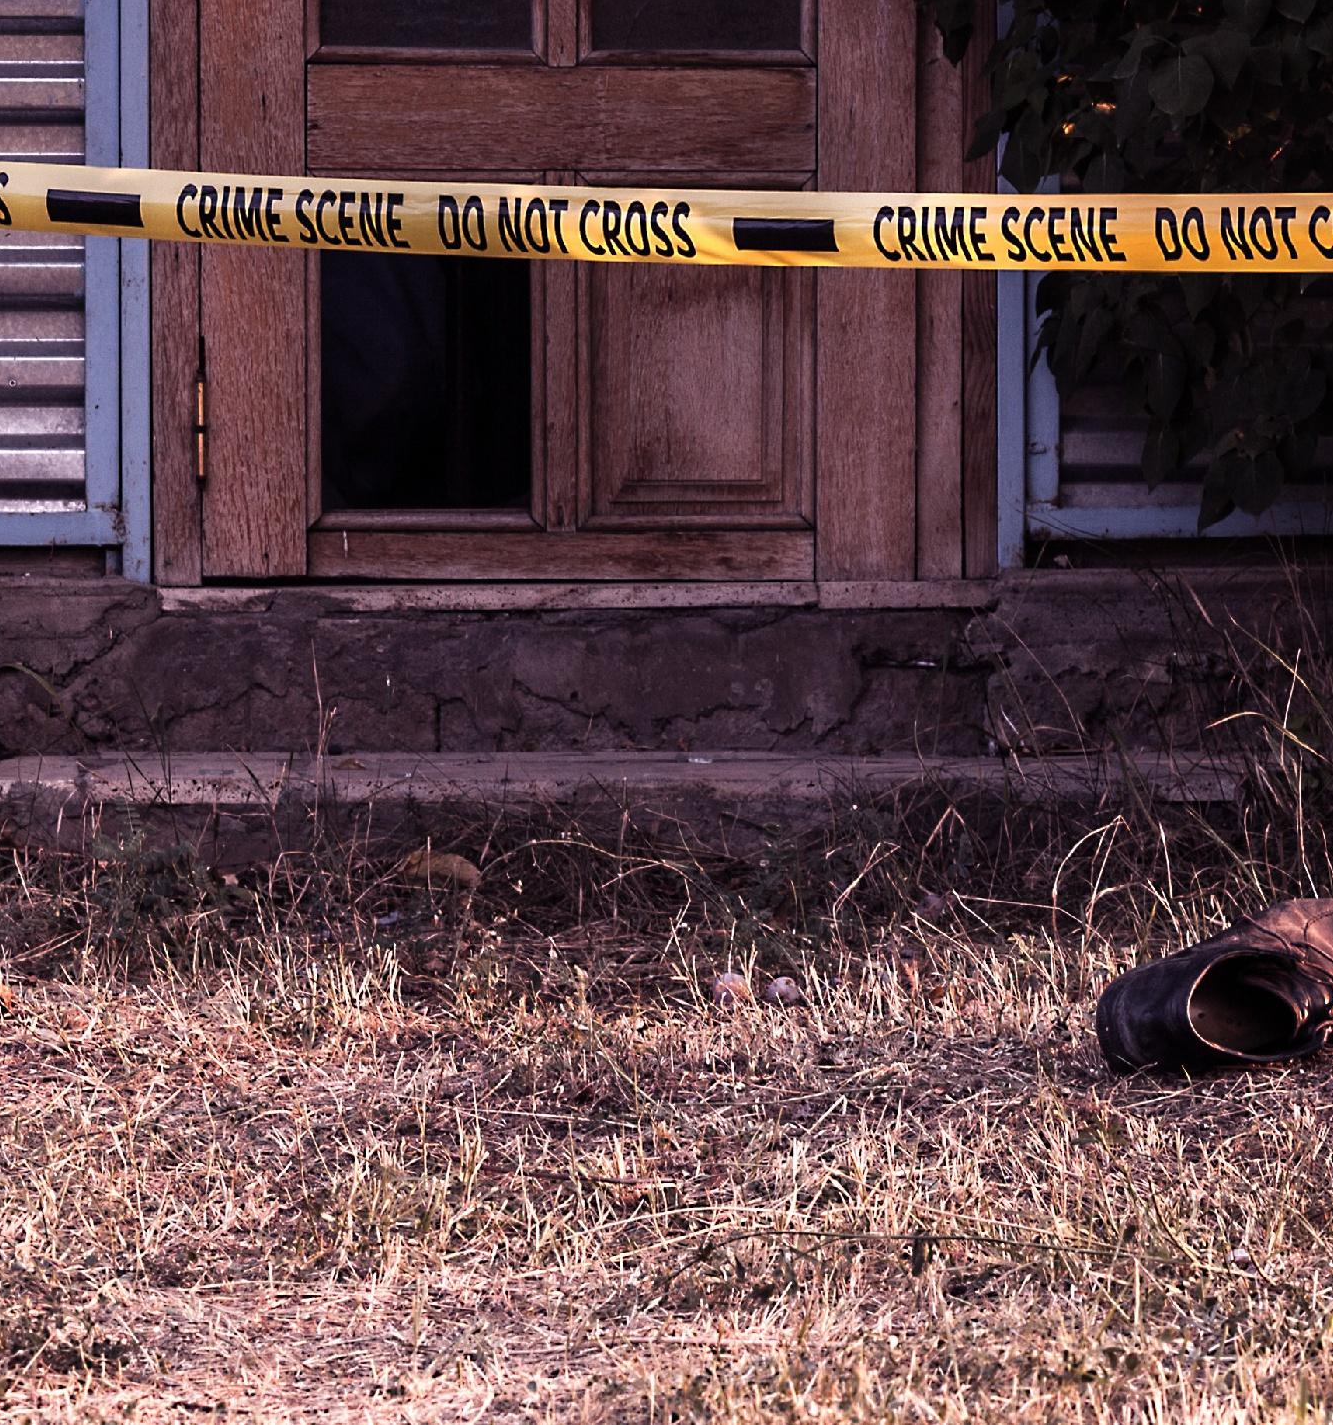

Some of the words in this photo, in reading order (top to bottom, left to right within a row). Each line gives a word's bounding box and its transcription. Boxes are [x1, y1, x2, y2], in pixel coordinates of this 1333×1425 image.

[176, 183, 290, 243] CRIME
[298, 188, 411, 249] SCENE
[438, 195, 487, 251] DO
[497, 197, 570, 254] NOT
[578, 199, 697, 259] CROSS
[872, 206, 996, 262] CRIME
[1000, 206, 1127, 263] SCENE
[1154, 206, 1211, 262] DO
[1219, 206, 1300, 261] NOT
